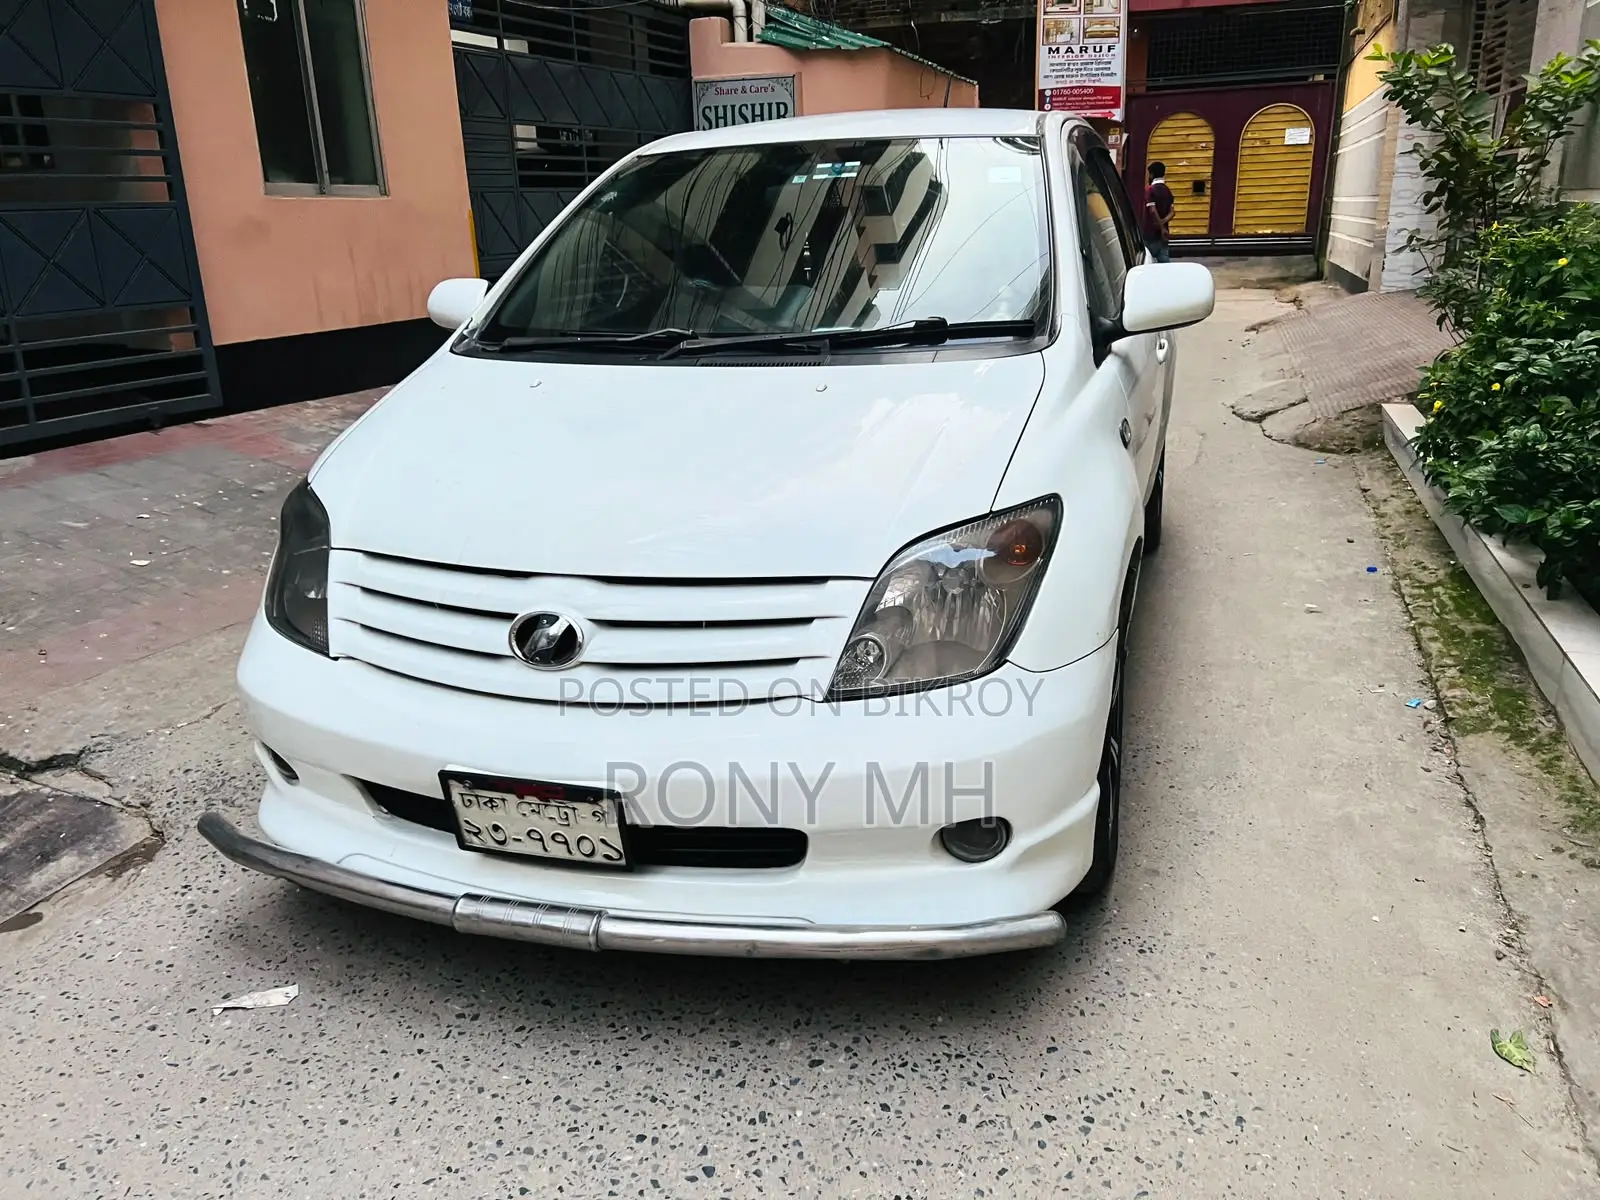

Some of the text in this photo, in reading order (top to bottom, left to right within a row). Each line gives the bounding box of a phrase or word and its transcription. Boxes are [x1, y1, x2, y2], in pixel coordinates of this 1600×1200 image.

[1048, 45, 1116, 55] MARUF
[714, 83, 776, 96] Share & Care's
[701, 101, 789, 131] SHISHIR
[458, 792, 508, 815] ঢাকা
[463, 817, 624, 862] ২৩-৭৭০১
